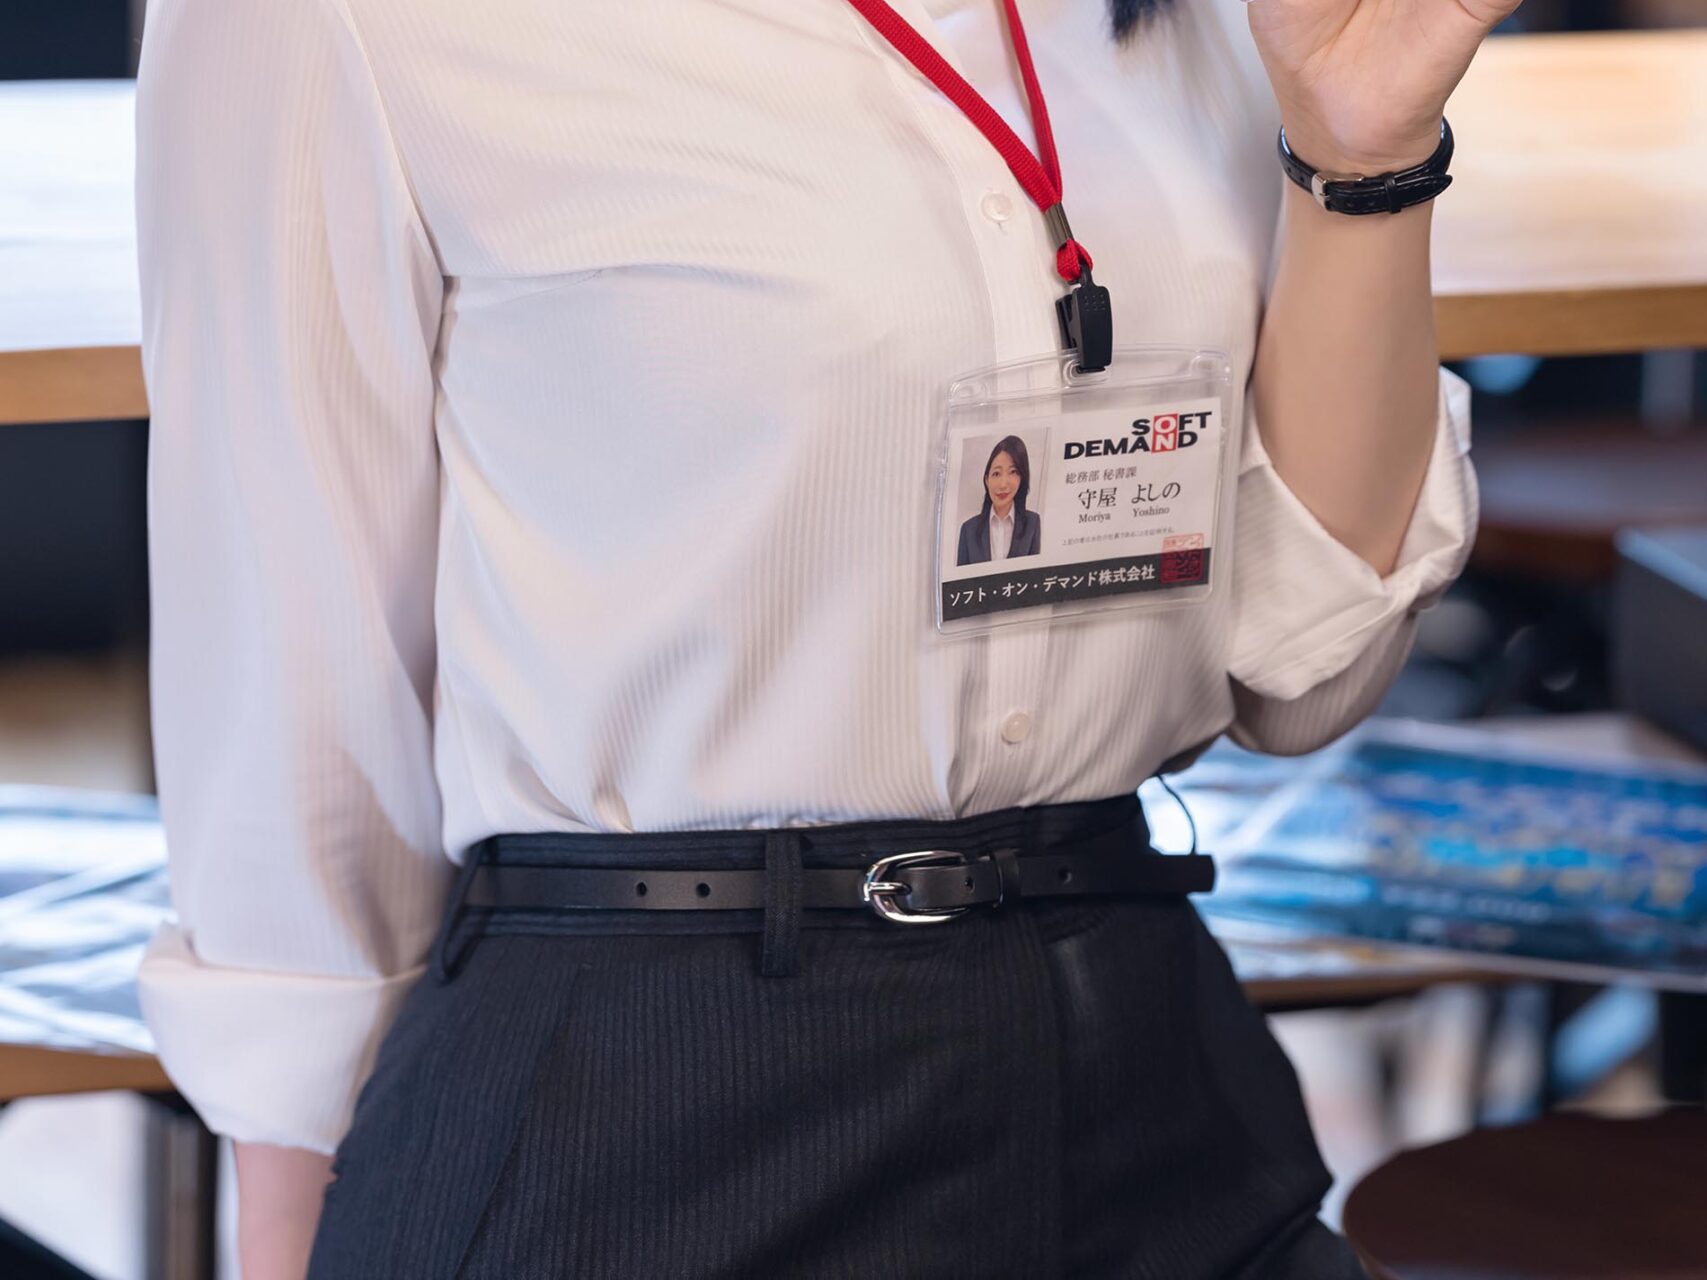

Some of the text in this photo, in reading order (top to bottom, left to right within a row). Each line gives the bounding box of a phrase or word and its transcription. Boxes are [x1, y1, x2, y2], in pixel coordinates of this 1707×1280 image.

[1131, 411, 1213, 436] SOFT
[1063, 431, 1198, 460] DEMAND
[1065, 466, 1138, 485] 総務部 秘書課
[1078, 482, 1181, 510] 守屋 よしの
[1078, 505, 1170, 524] Moriya Yoshino
[950, 563, 1156, 607] ソフト・オン・デマンド株式会社
